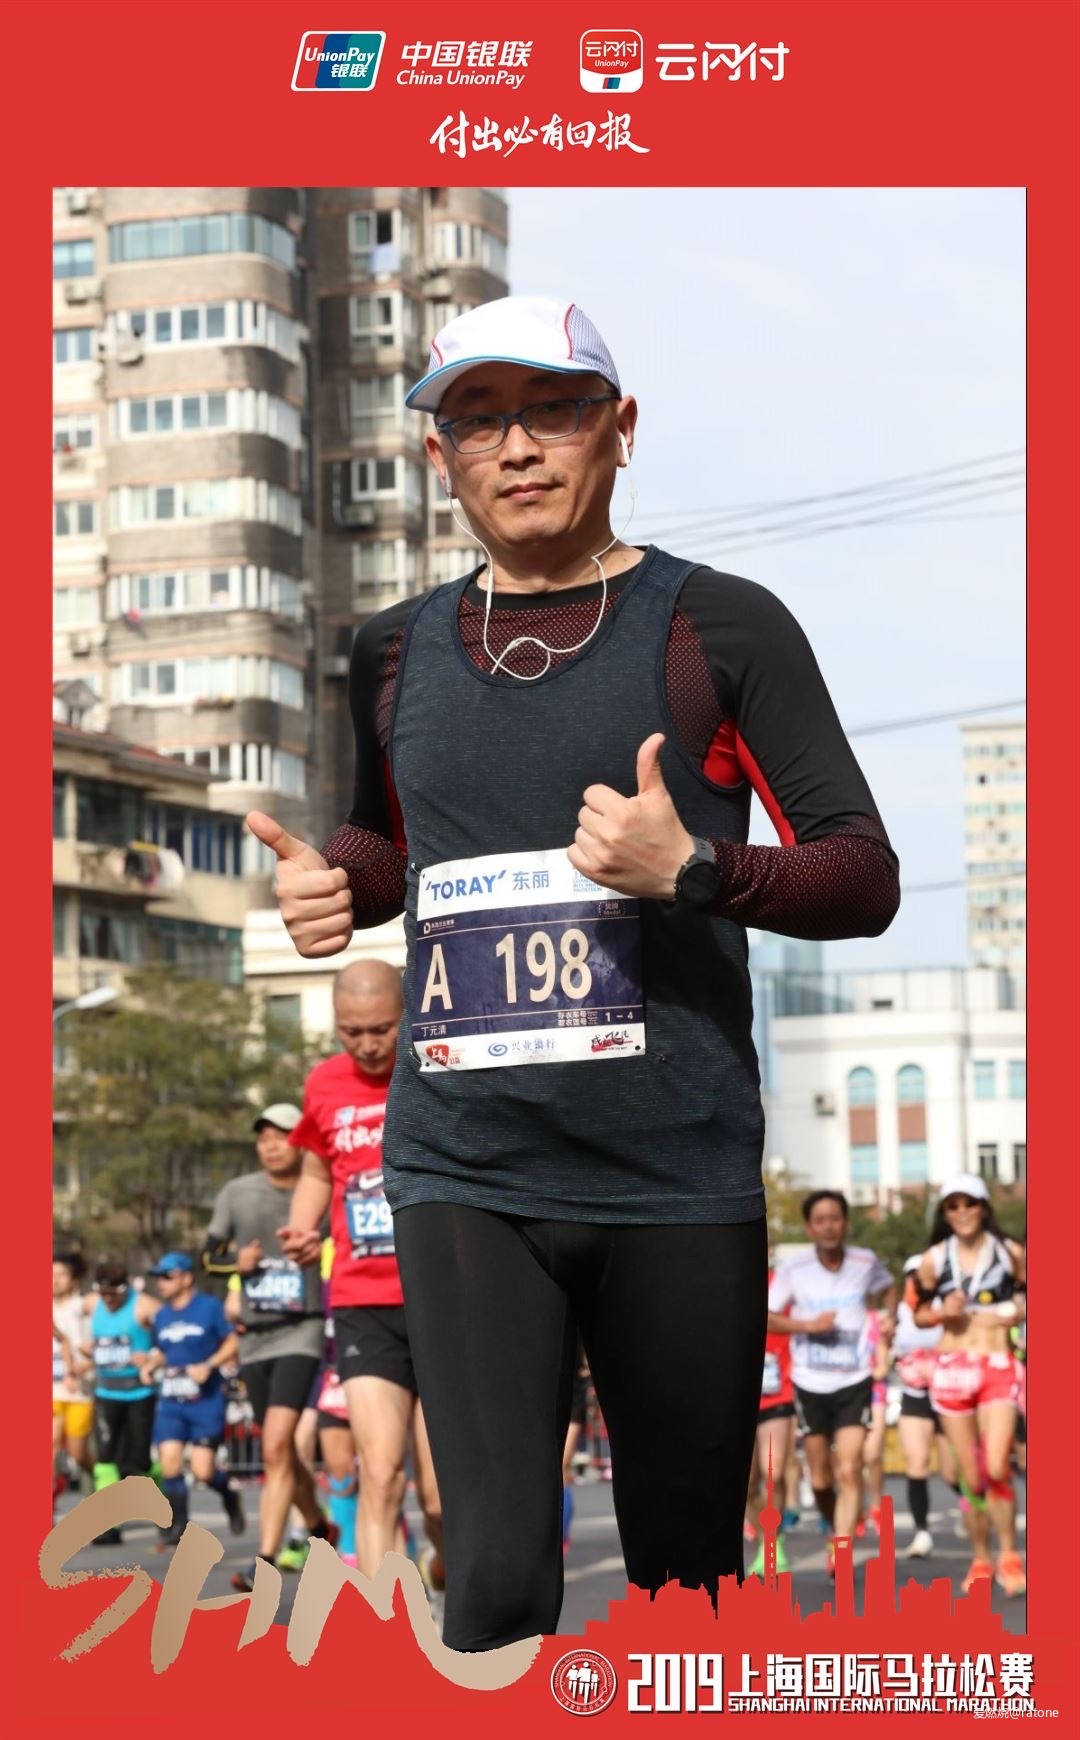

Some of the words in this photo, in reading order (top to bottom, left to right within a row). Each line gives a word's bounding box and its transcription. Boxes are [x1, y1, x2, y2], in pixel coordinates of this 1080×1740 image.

[512, 870, 550, 892] 东丽
[421, 944, 453, 1013] A
[496, 928, 592, 1003] 198
[605, 1012, 611, 1022] 1
[627, 1011, 634, 1020] 4
[421, 1024, 447, 1037] 丁元清
